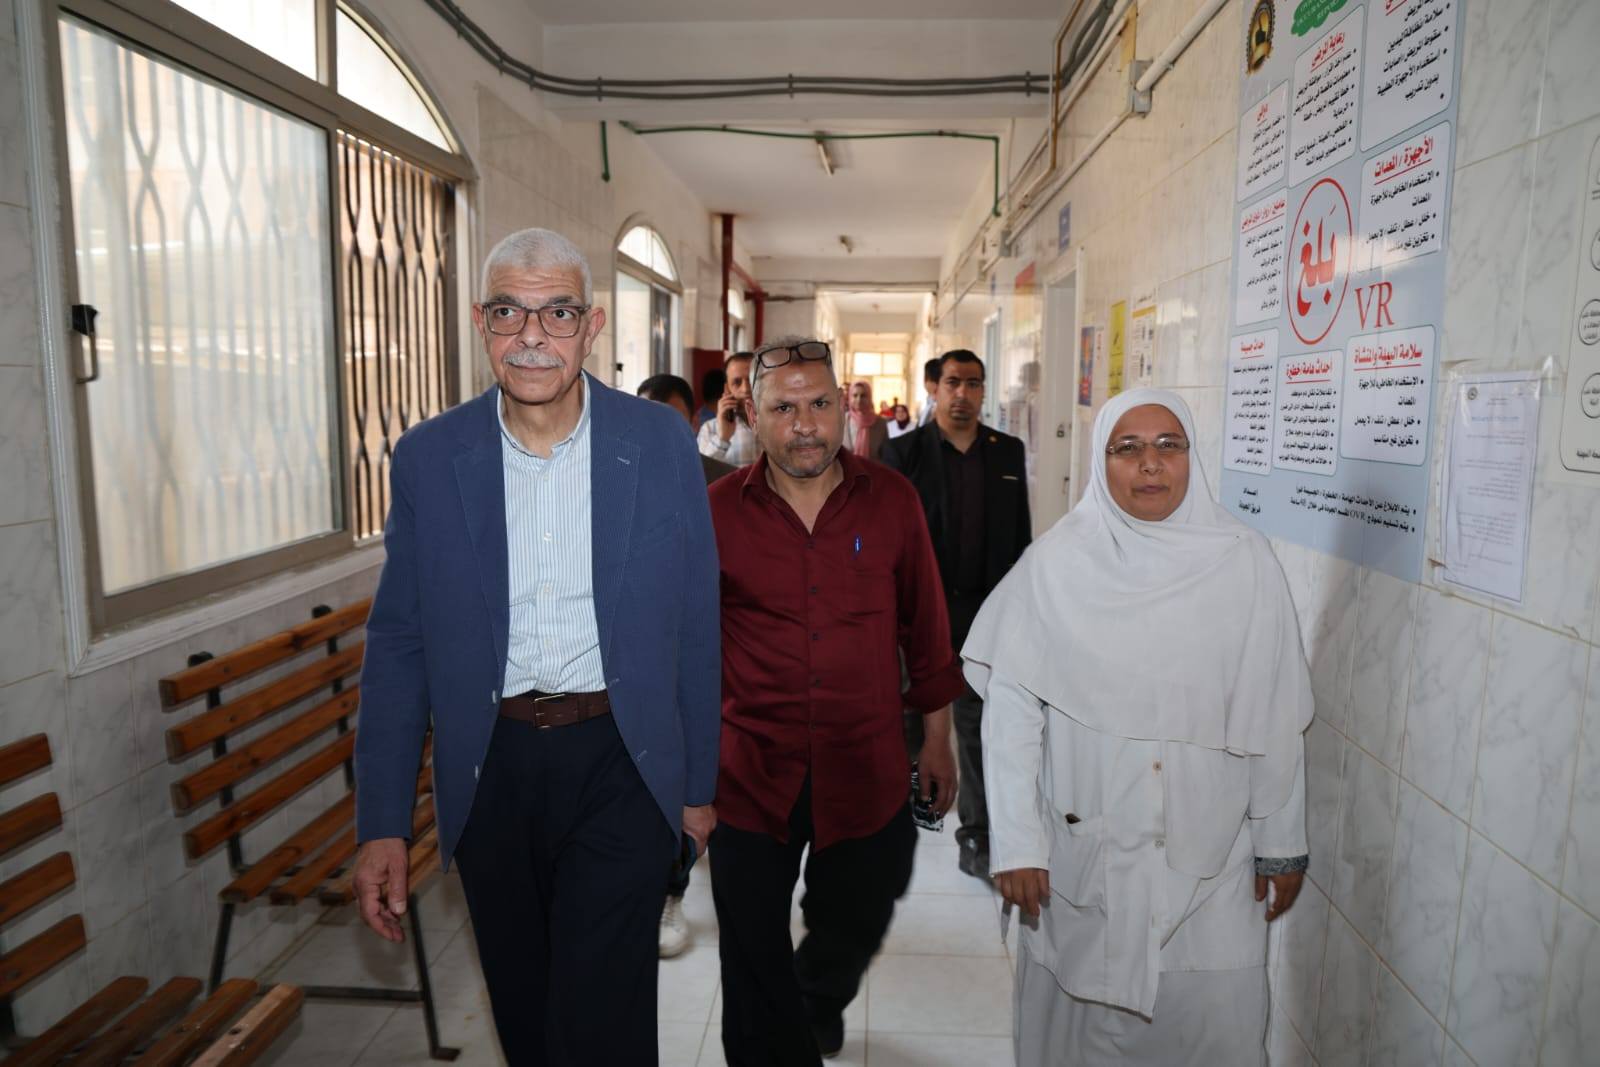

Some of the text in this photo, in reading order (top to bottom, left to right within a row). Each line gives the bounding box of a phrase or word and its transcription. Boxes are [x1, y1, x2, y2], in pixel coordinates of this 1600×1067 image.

[1404, 136, 1433, 167] الأجهزة
[1374, 155, 1398, 177] المعدات
[1378, 346, 1398, 366] البيئة
[1399, 344, 1422, 360] سلامة
